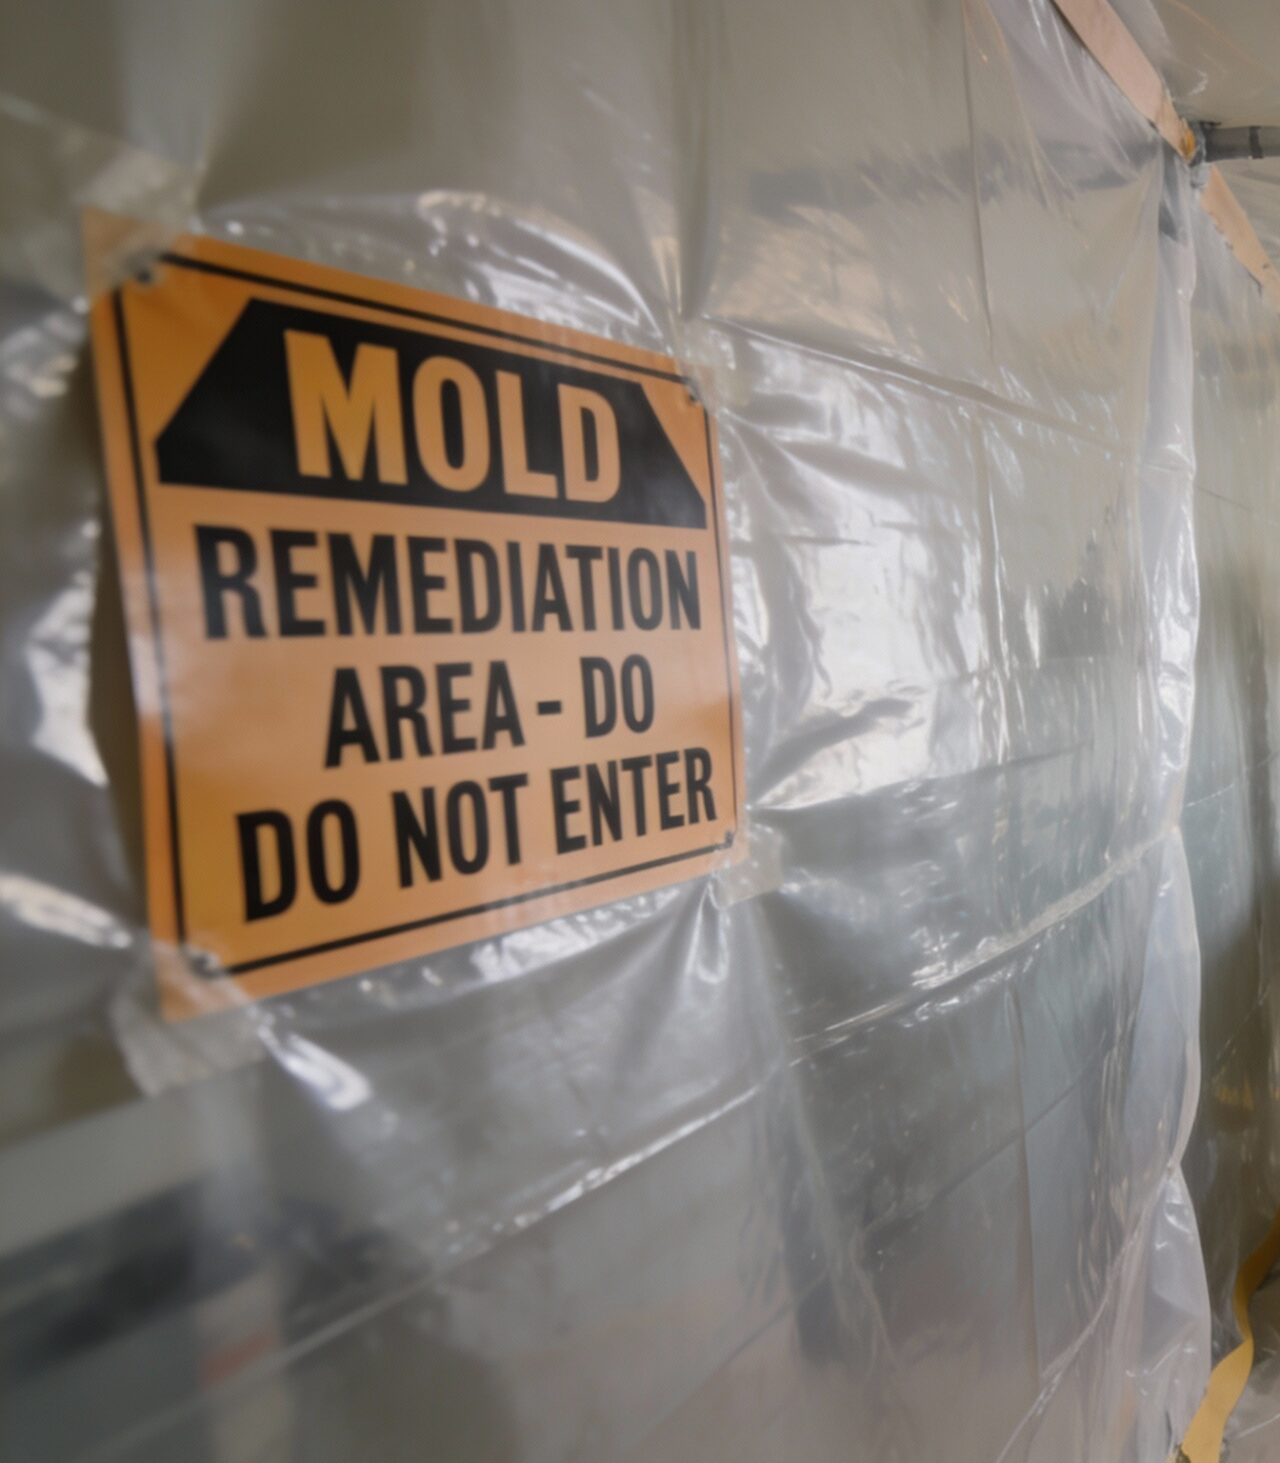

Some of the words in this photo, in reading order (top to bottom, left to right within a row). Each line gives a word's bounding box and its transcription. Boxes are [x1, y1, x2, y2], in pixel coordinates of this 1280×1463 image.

[283, 328, 621, 503] MOLD
[193, 523, 704, 642] REMEDIATION
[323, 660, 526, 769] AREA
[581, 654, 656, 739] DO
[235, 798, 361, 924] DO
[391, 773, 529, 890] NOT
[550, 747, 718, 857] ENTER
